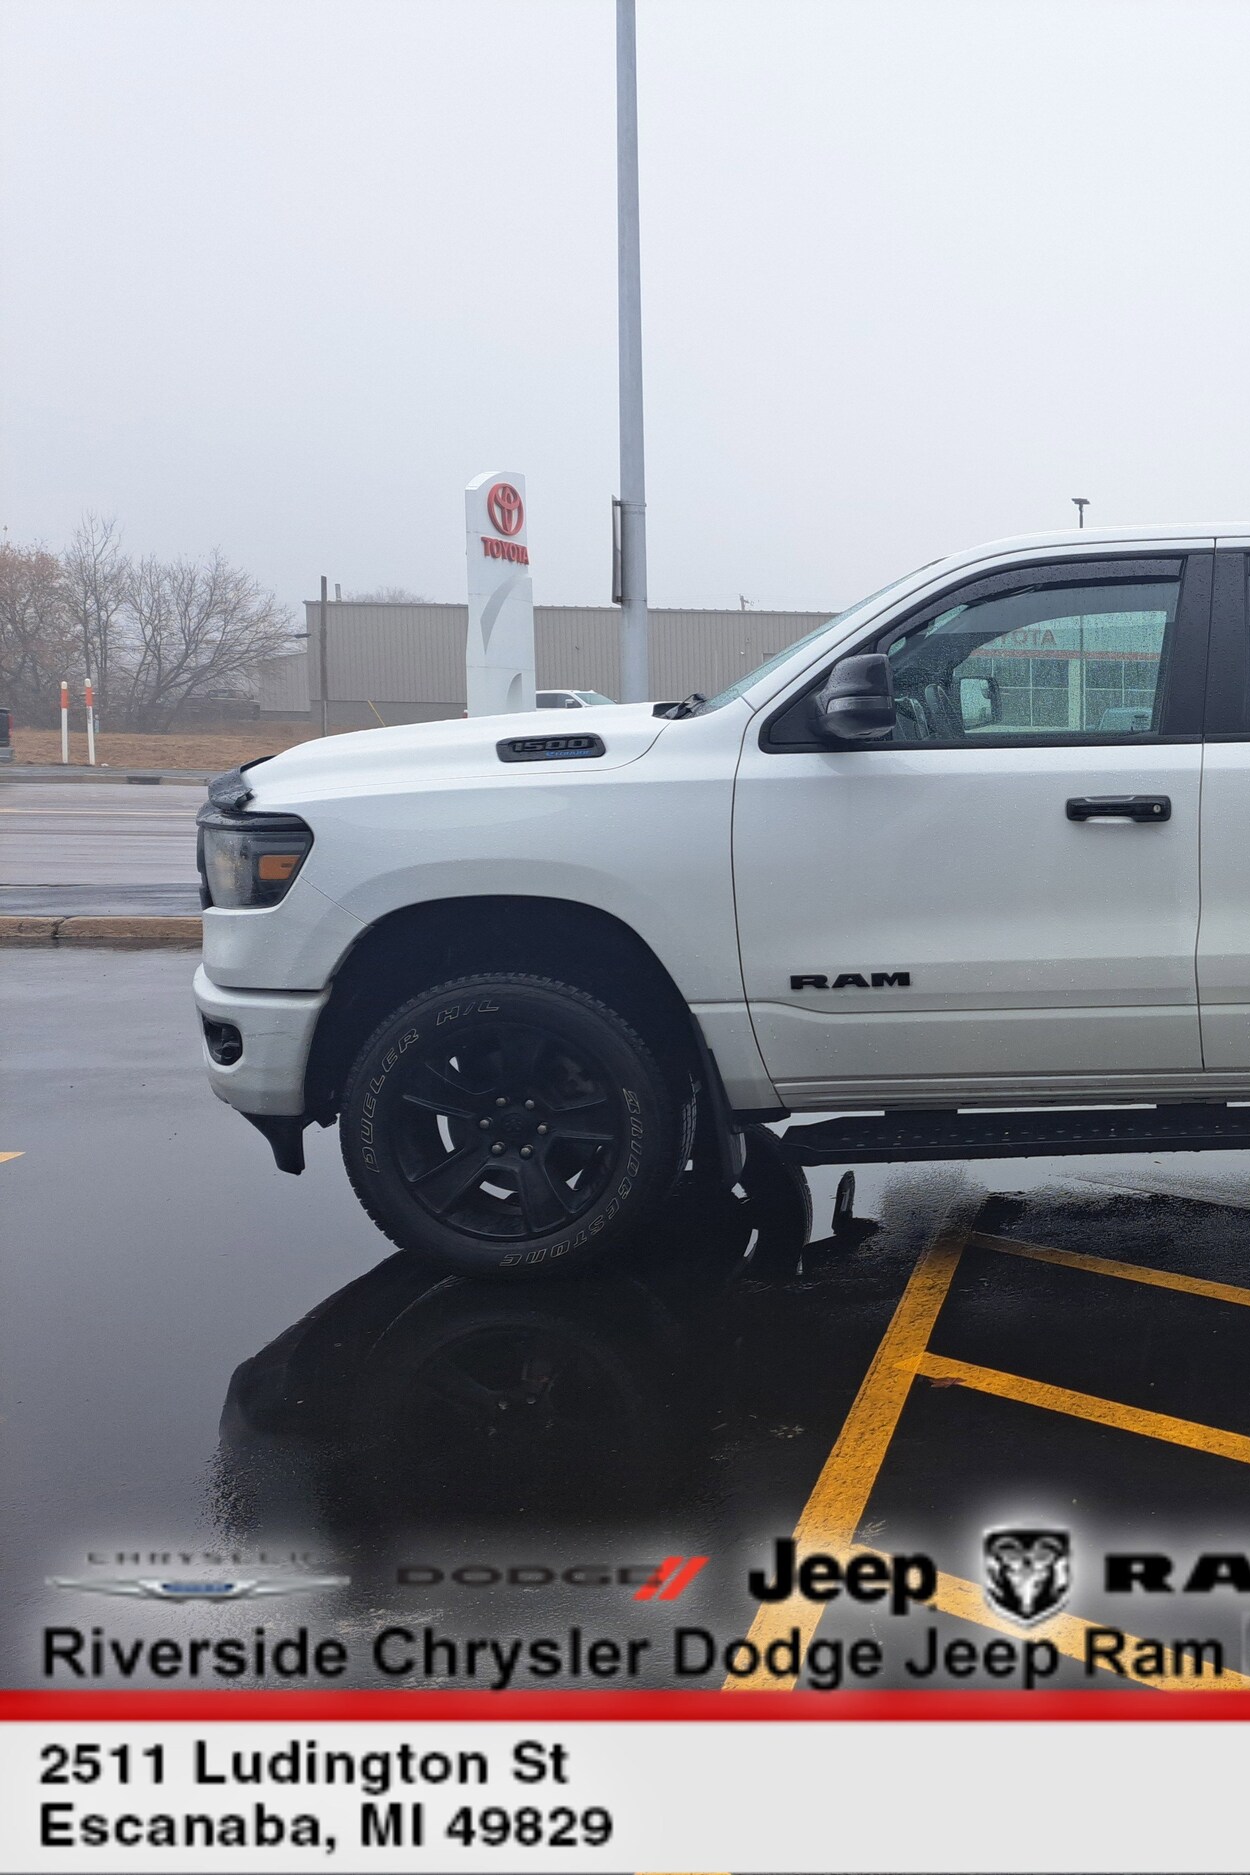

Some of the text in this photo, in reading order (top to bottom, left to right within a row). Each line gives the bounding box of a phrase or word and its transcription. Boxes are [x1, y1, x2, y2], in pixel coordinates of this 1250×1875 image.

[481, 536, 529, 565] TOYOTA
[512, 738, 593, 753] 1500
[790, 972, 911, 990] RAM
[361, 1028, 419, 1173] DUELER
[499, 1087, 643, 1267] BRIDGESTONE
